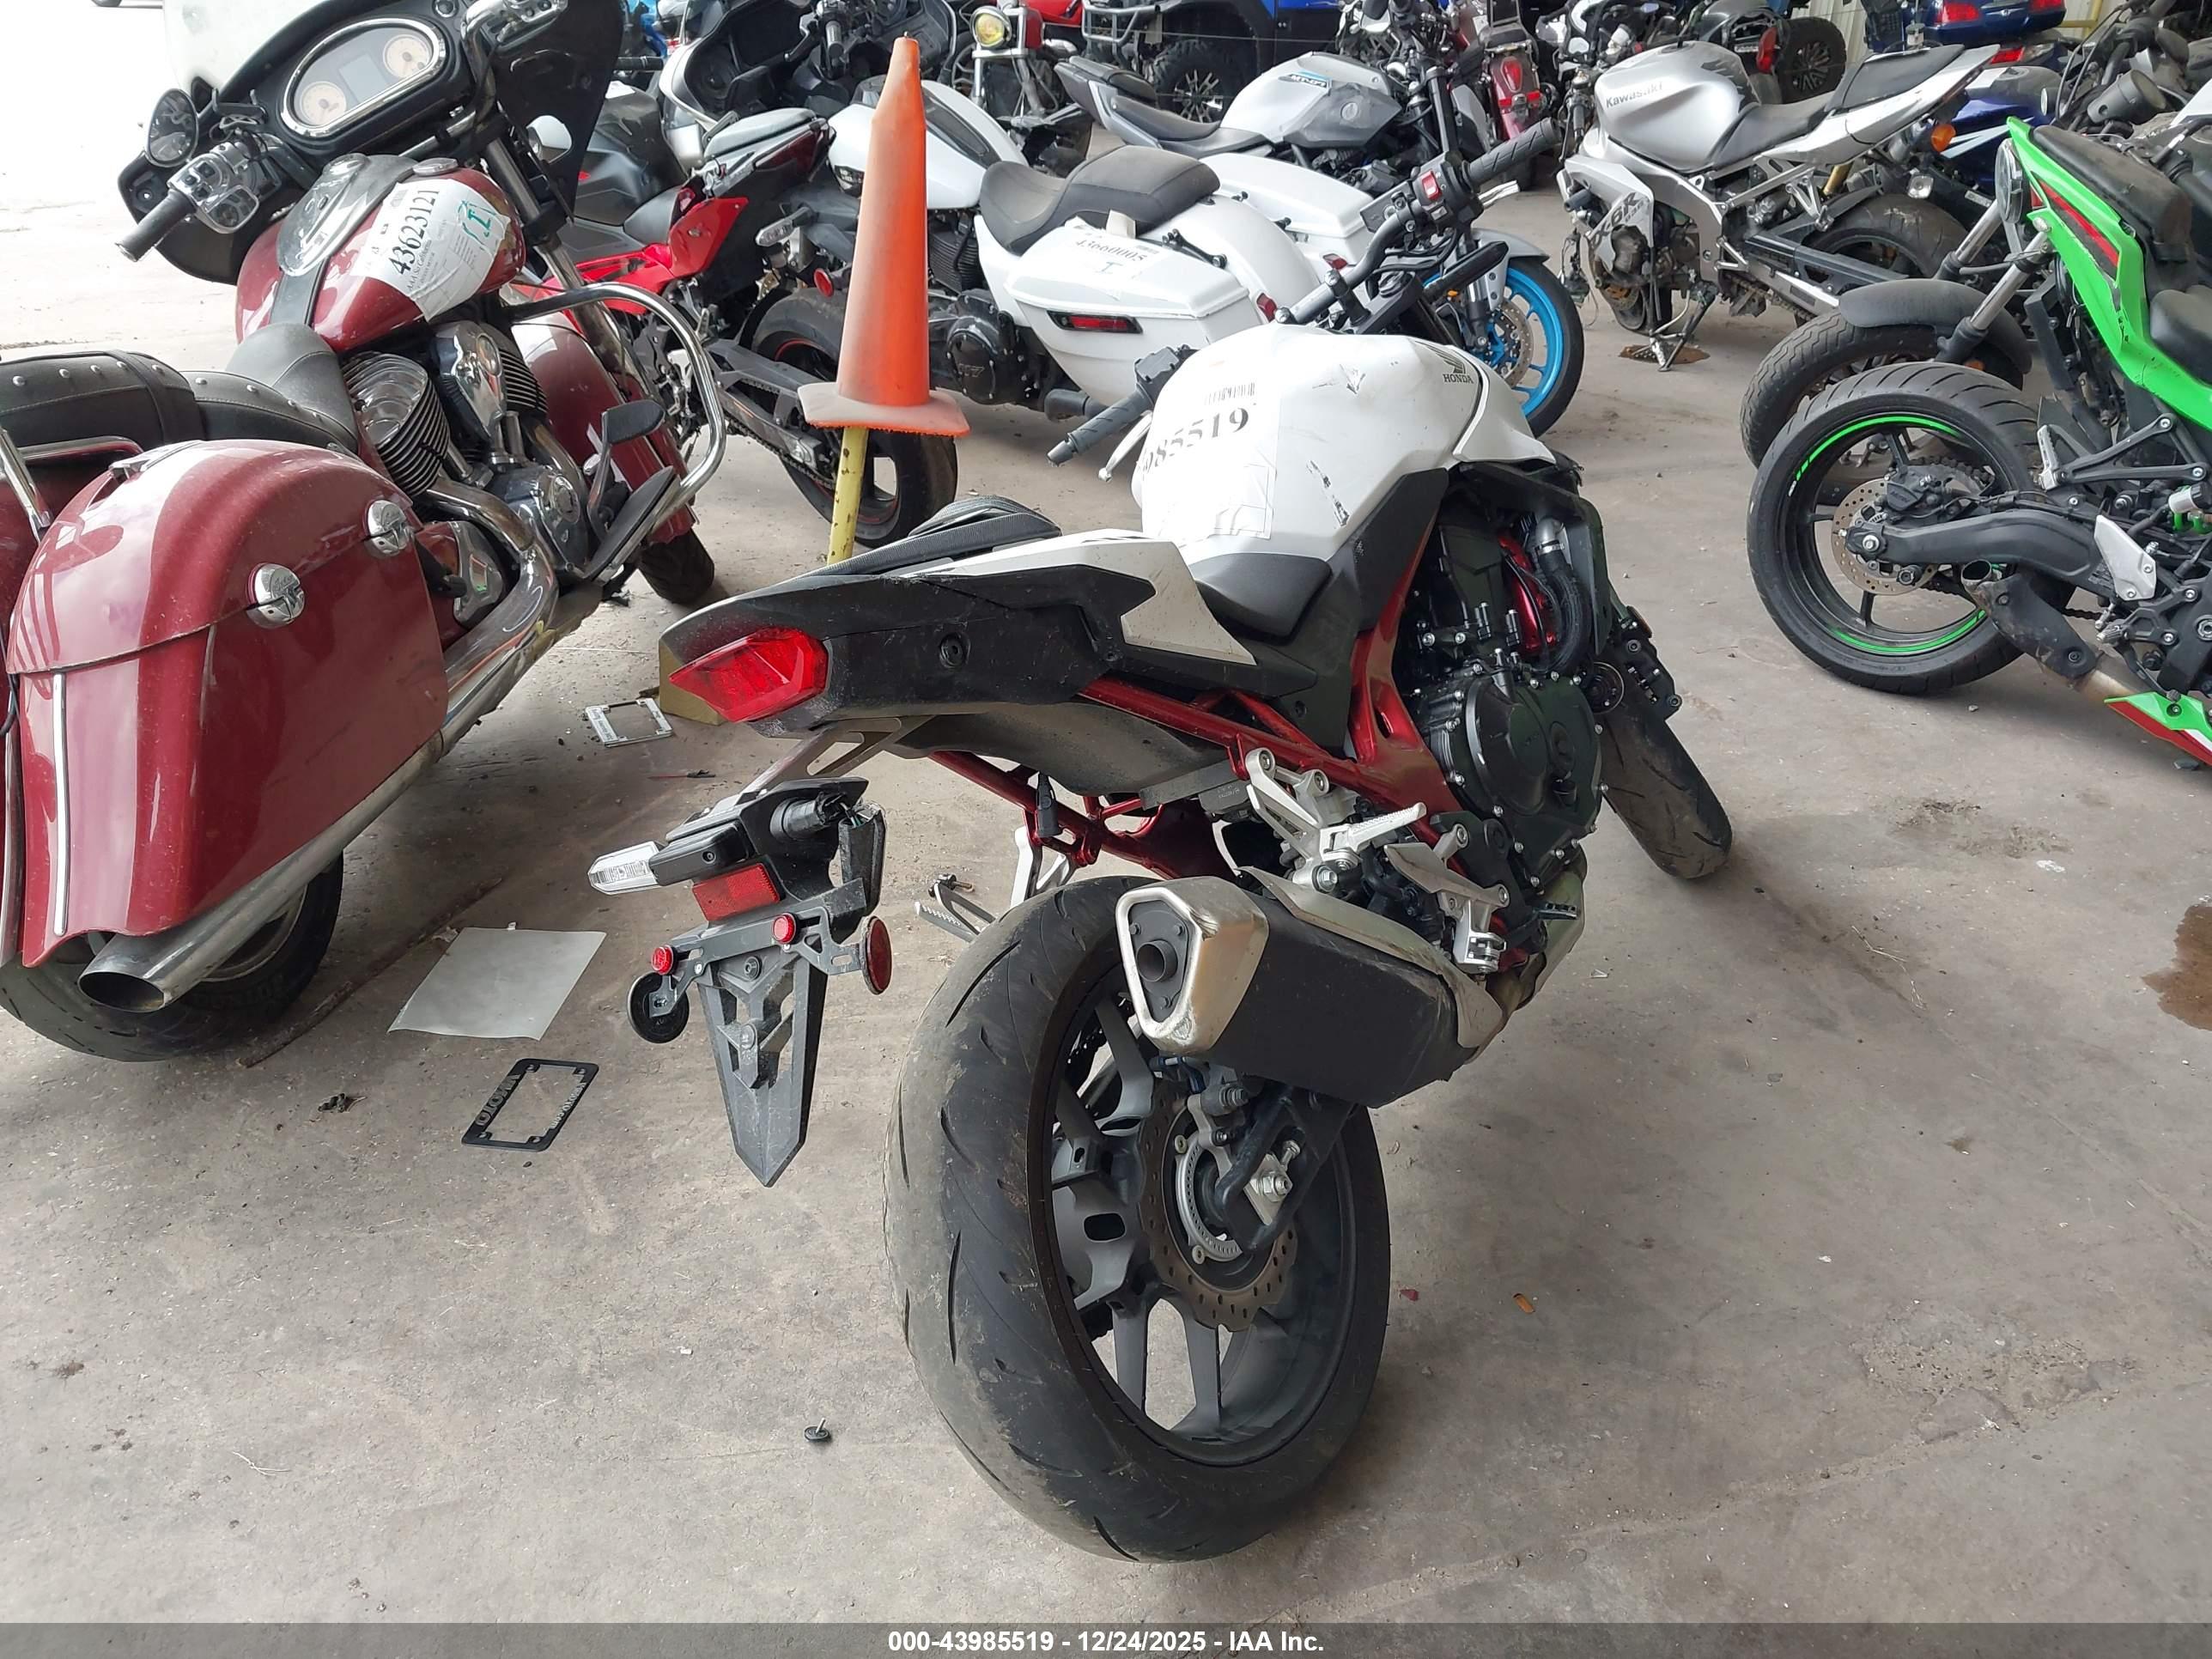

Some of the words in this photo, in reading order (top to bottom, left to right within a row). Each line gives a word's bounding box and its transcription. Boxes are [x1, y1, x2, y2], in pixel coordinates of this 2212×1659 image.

[1606, 82, 1662, 108] Kawasaki
[388, 190, 441, 275] 43623121
[1443, 374, 1474, 385] HONDA
